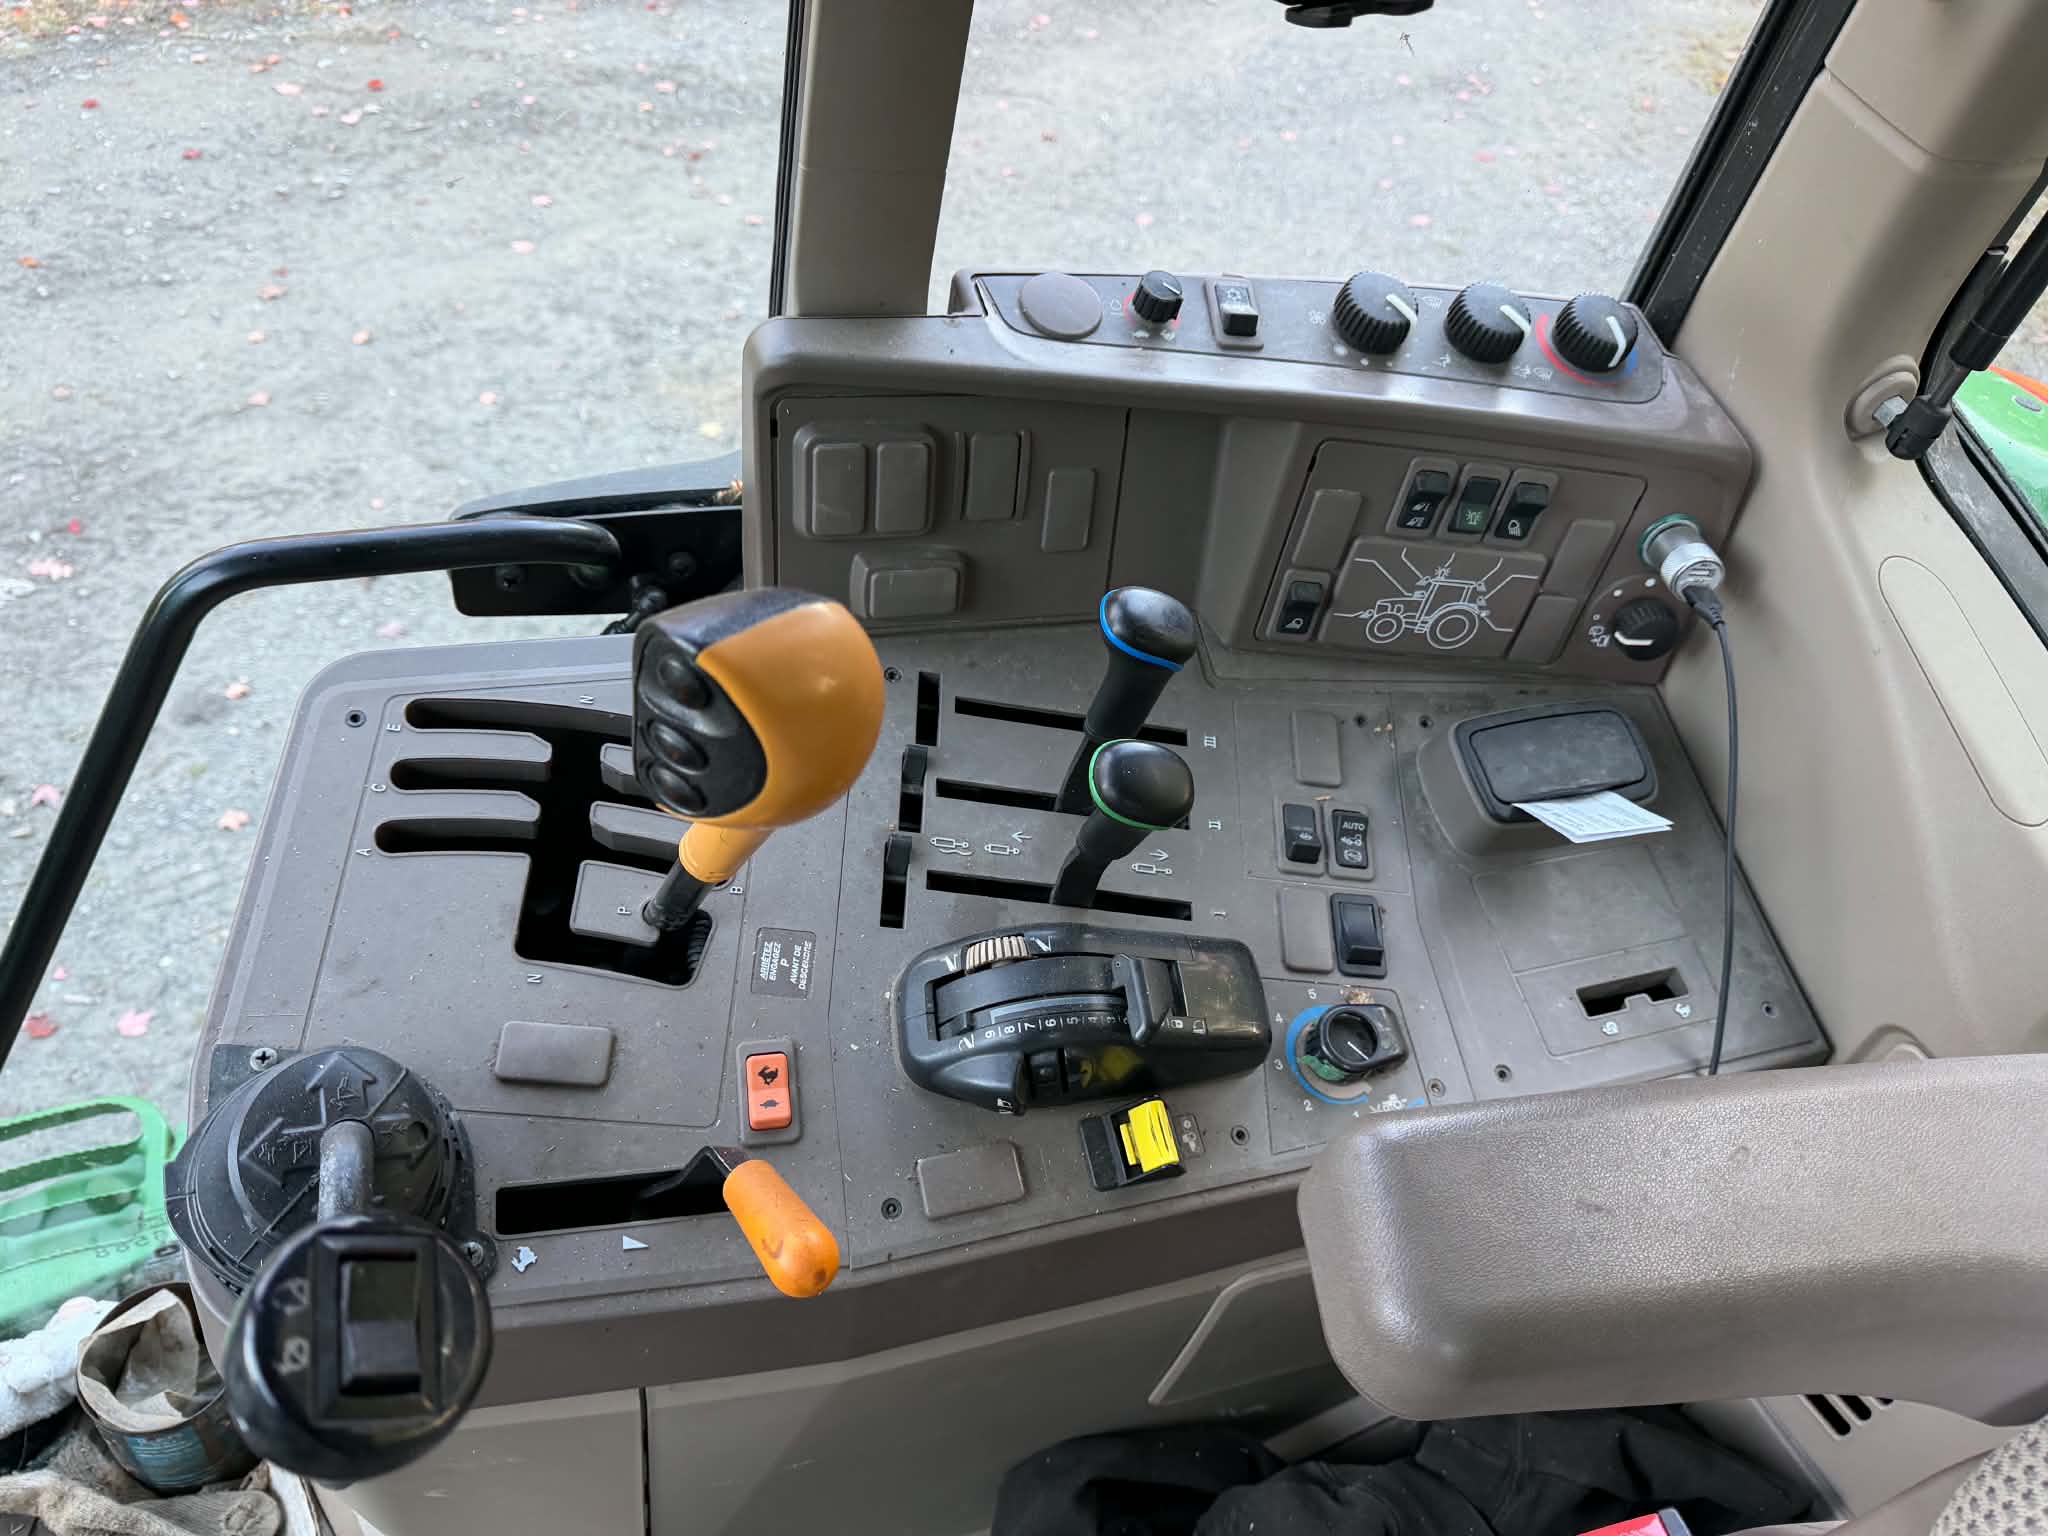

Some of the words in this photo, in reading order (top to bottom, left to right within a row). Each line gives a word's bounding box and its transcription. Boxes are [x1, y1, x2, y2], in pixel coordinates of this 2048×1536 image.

[387, 722, 401, 732] E
[370, 783, 386, 793] C
[1342, 820, 1366, 830] AUTO
[356, 847, 372, 857] A
[731, 885, 743, 894] B
[617, 906, 631, 915] P
[793, 945, 802, 957] DE
[769, 941, 781, 981] ENGAGEZ
[780, 958, 790, 967] P
[798, 940, 812, 990] DESCENDRE
[790, 957, 799, 984] AVANT
[527, 973, 542, 984] N
[1308, 989, 1317, 999] 5
[1275, 1013, 1283, 1024] 4
[1004, 1025, 1016, 1034] 8
[1024, 1023, 1036, 1031] 7
[1045, 1018, 1056, 1027] 6
[1067, 1017, 1078, 1025] 5
[1274, 1059, 1283, 1070] 3
[1304, 1100, 1312, 1111] 2
